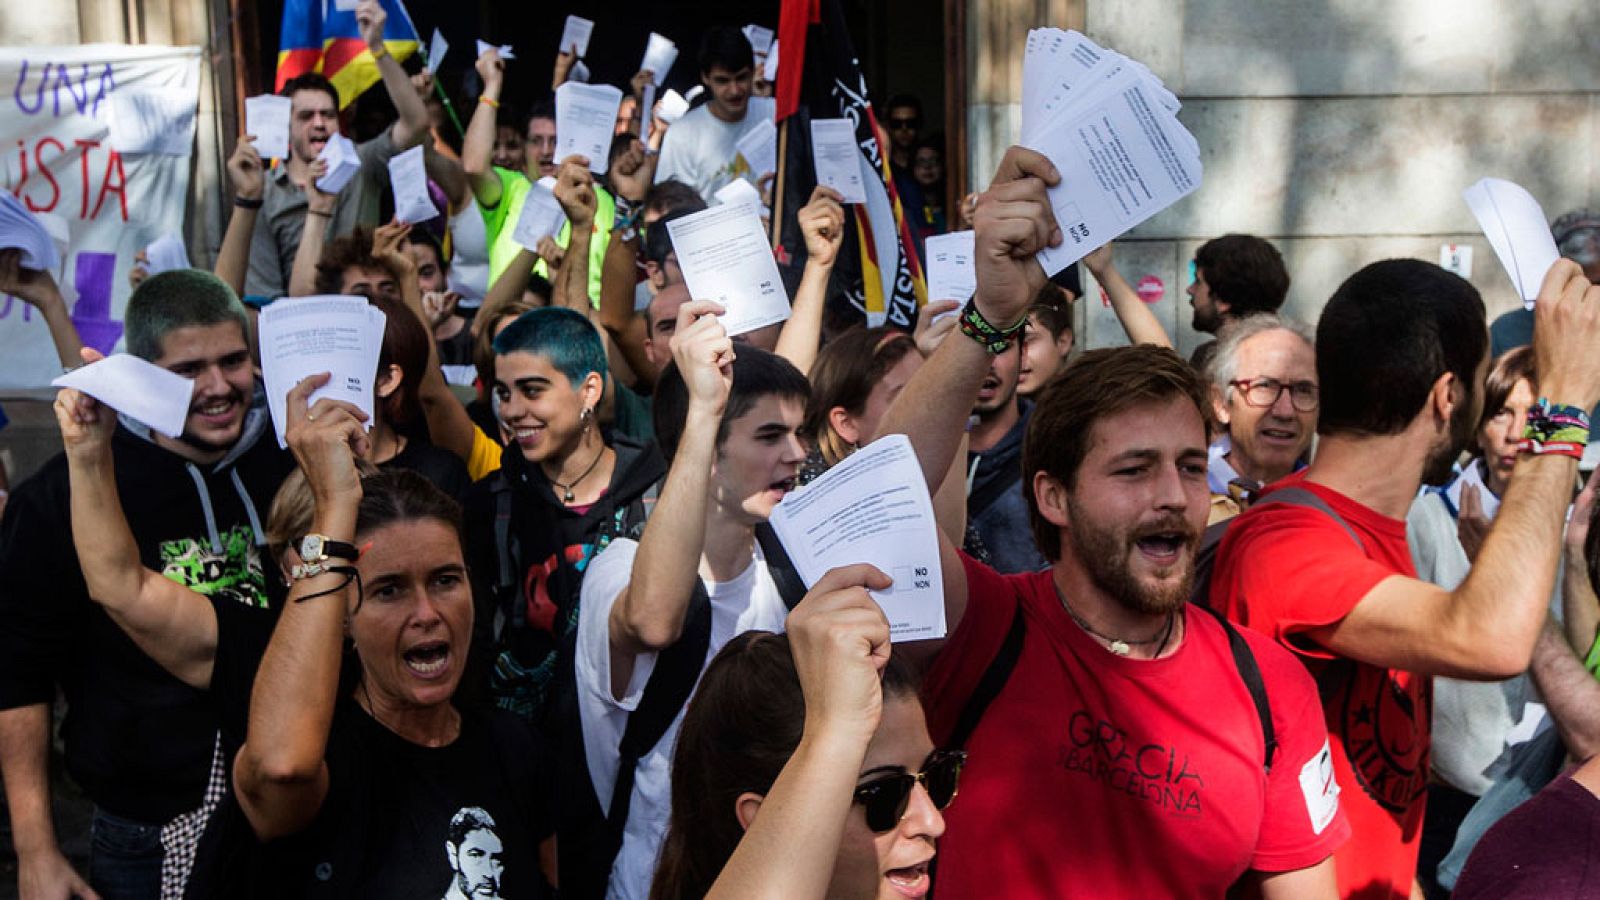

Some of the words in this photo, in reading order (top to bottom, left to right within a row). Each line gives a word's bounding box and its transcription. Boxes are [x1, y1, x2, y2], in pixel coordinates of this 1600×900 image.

[14, 58, 116, 118] UNA
[1077, 222, 1090, 238] NO
[914, 567, 928, 576] NO
[914, 580, 930, 589] NON
